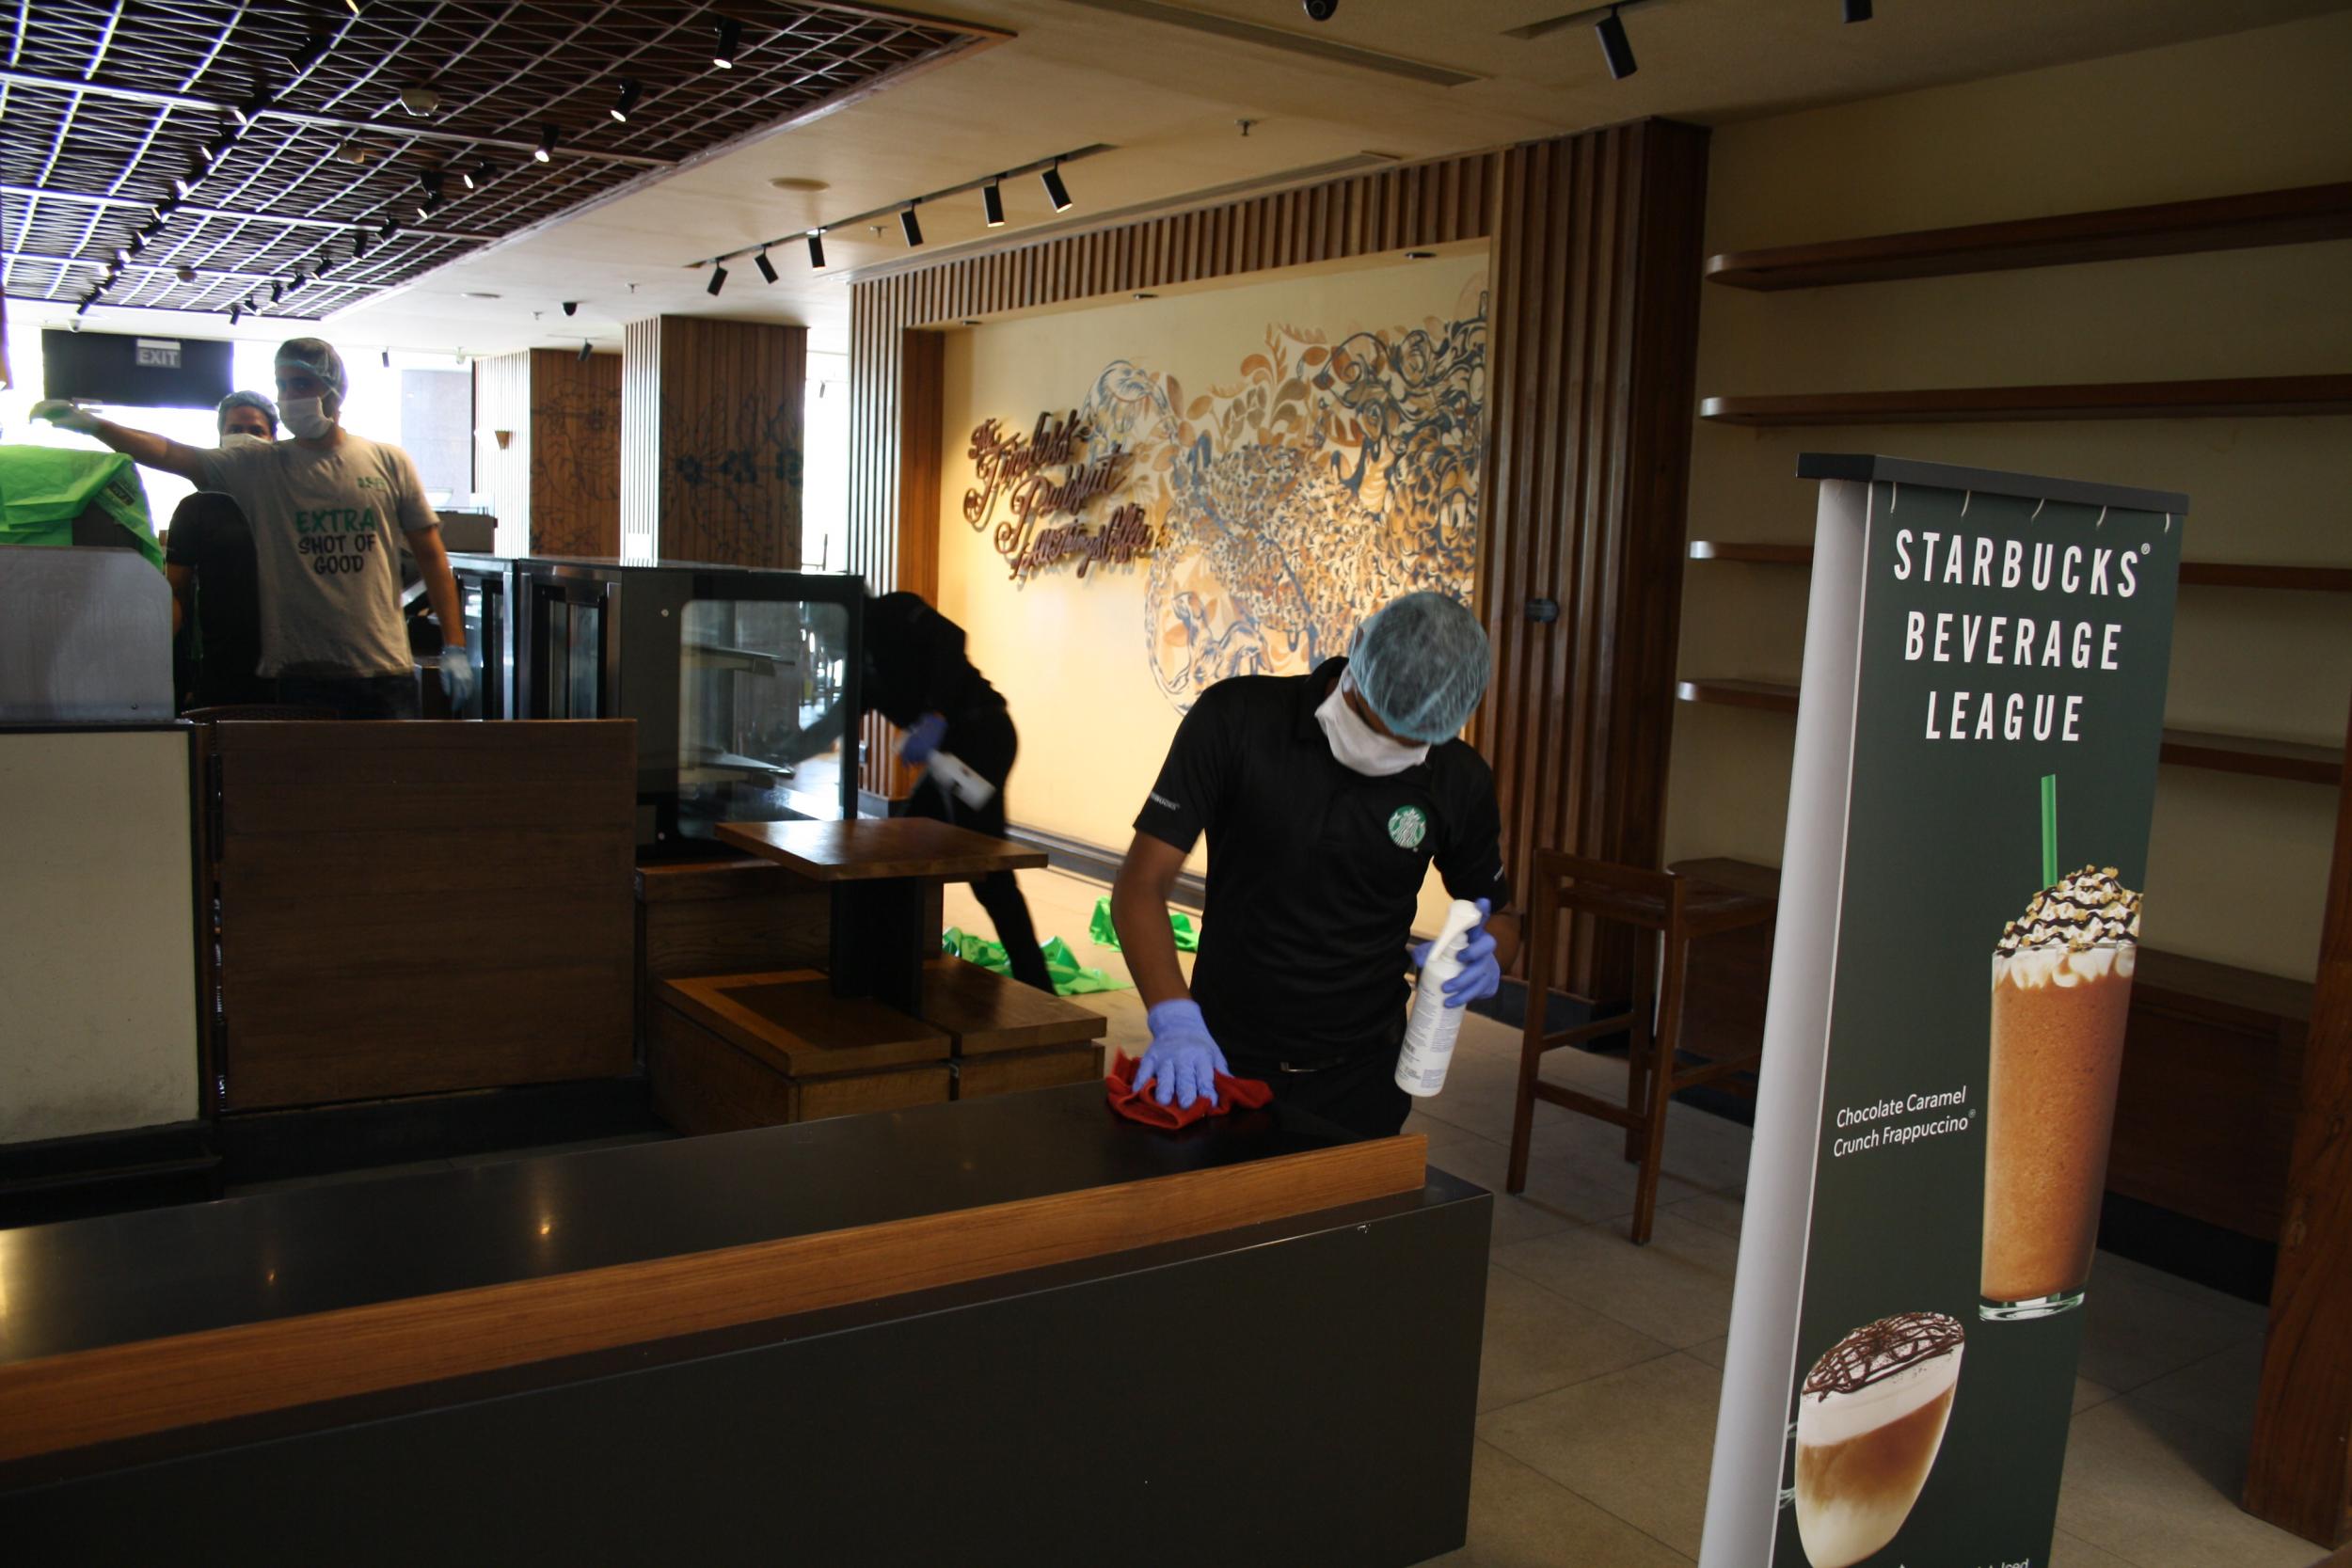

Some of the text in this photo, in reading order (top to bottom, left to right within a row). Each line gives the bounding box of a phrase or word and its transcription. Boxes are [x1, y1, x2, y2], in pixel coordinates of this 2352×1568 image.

[139, 348, 178, 366] EXIT
[295, 507, 375, 533] EXTRA
[298, 533, 376, 555] SHOT OF
[313, 555, 365, 576] GOOD
[1904, 610, 2122, 671] BEVERAGE
[1925, 690, 2084, 742] LEAGUE
[1836, 1085, 1967, 1129] Chocolate Caramel
[1834, 1129, 1880, 1158] Crunch
